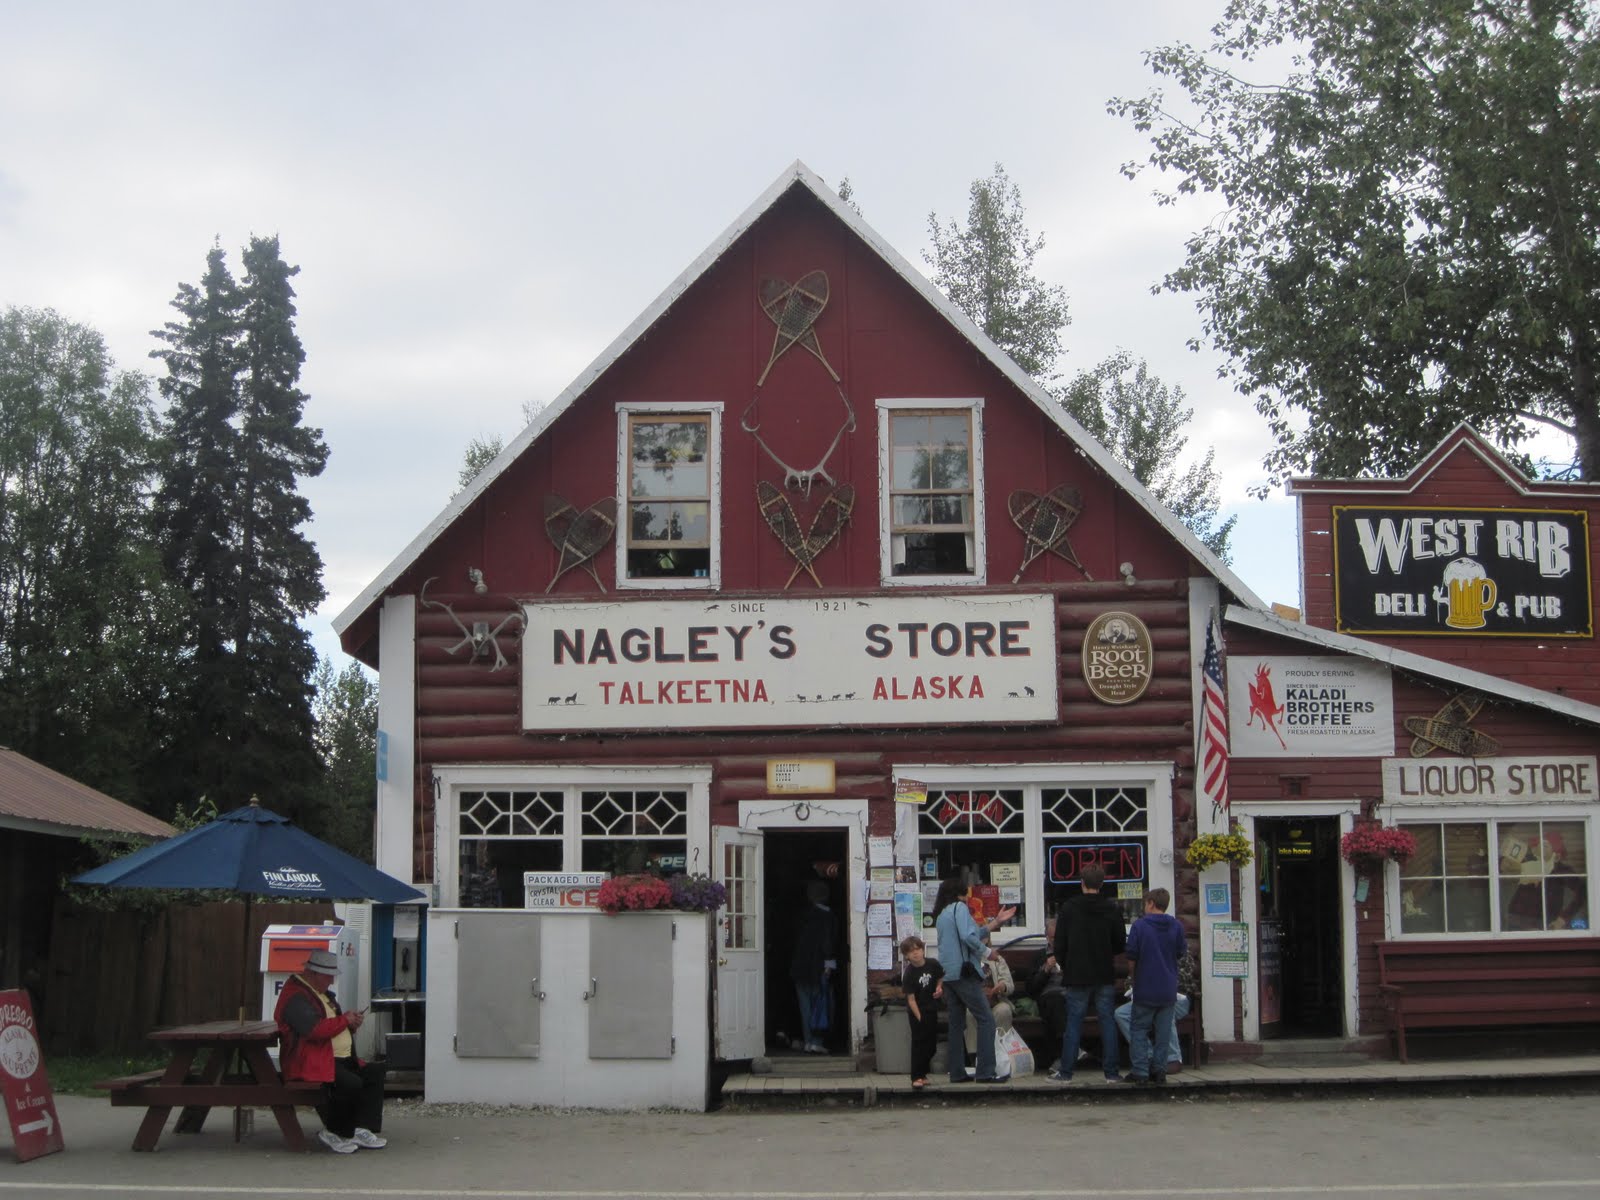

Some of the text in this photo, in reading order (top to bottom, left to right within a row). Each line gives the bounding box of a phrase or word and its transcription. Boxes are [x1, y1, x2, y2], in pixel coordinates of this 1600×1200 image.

[1354, 517, 1571, 578] WEST RIB
[729, 601, 848, 614] SINCE 1921
[1374, 592, 1562, 619] DELI & PUB
[552, 619, 1032, 666] NAGLEY'S STORE
[871, 673, 986, 702] ALASKA
[1286, 688, 1346, 701] KALADI
[1286, 701, 1375, 713] BROTHERS
[1287, 713, 1352, 726] COFFEE
[1399, 763, 1592, 797] LIQUOR STORE
[938, 793, 1005, 824] ATM
[1053, 847, 1141, 879] OPEN
[262, 871, 322, 883] FINLANDIA
[528, 875, 601, 885] PACKAGED ICE
[530, 886, 560, 898] CRYSTAL
[559, 889, 601, 907] ICE
[533, 898, 555, 906] CLEAR
